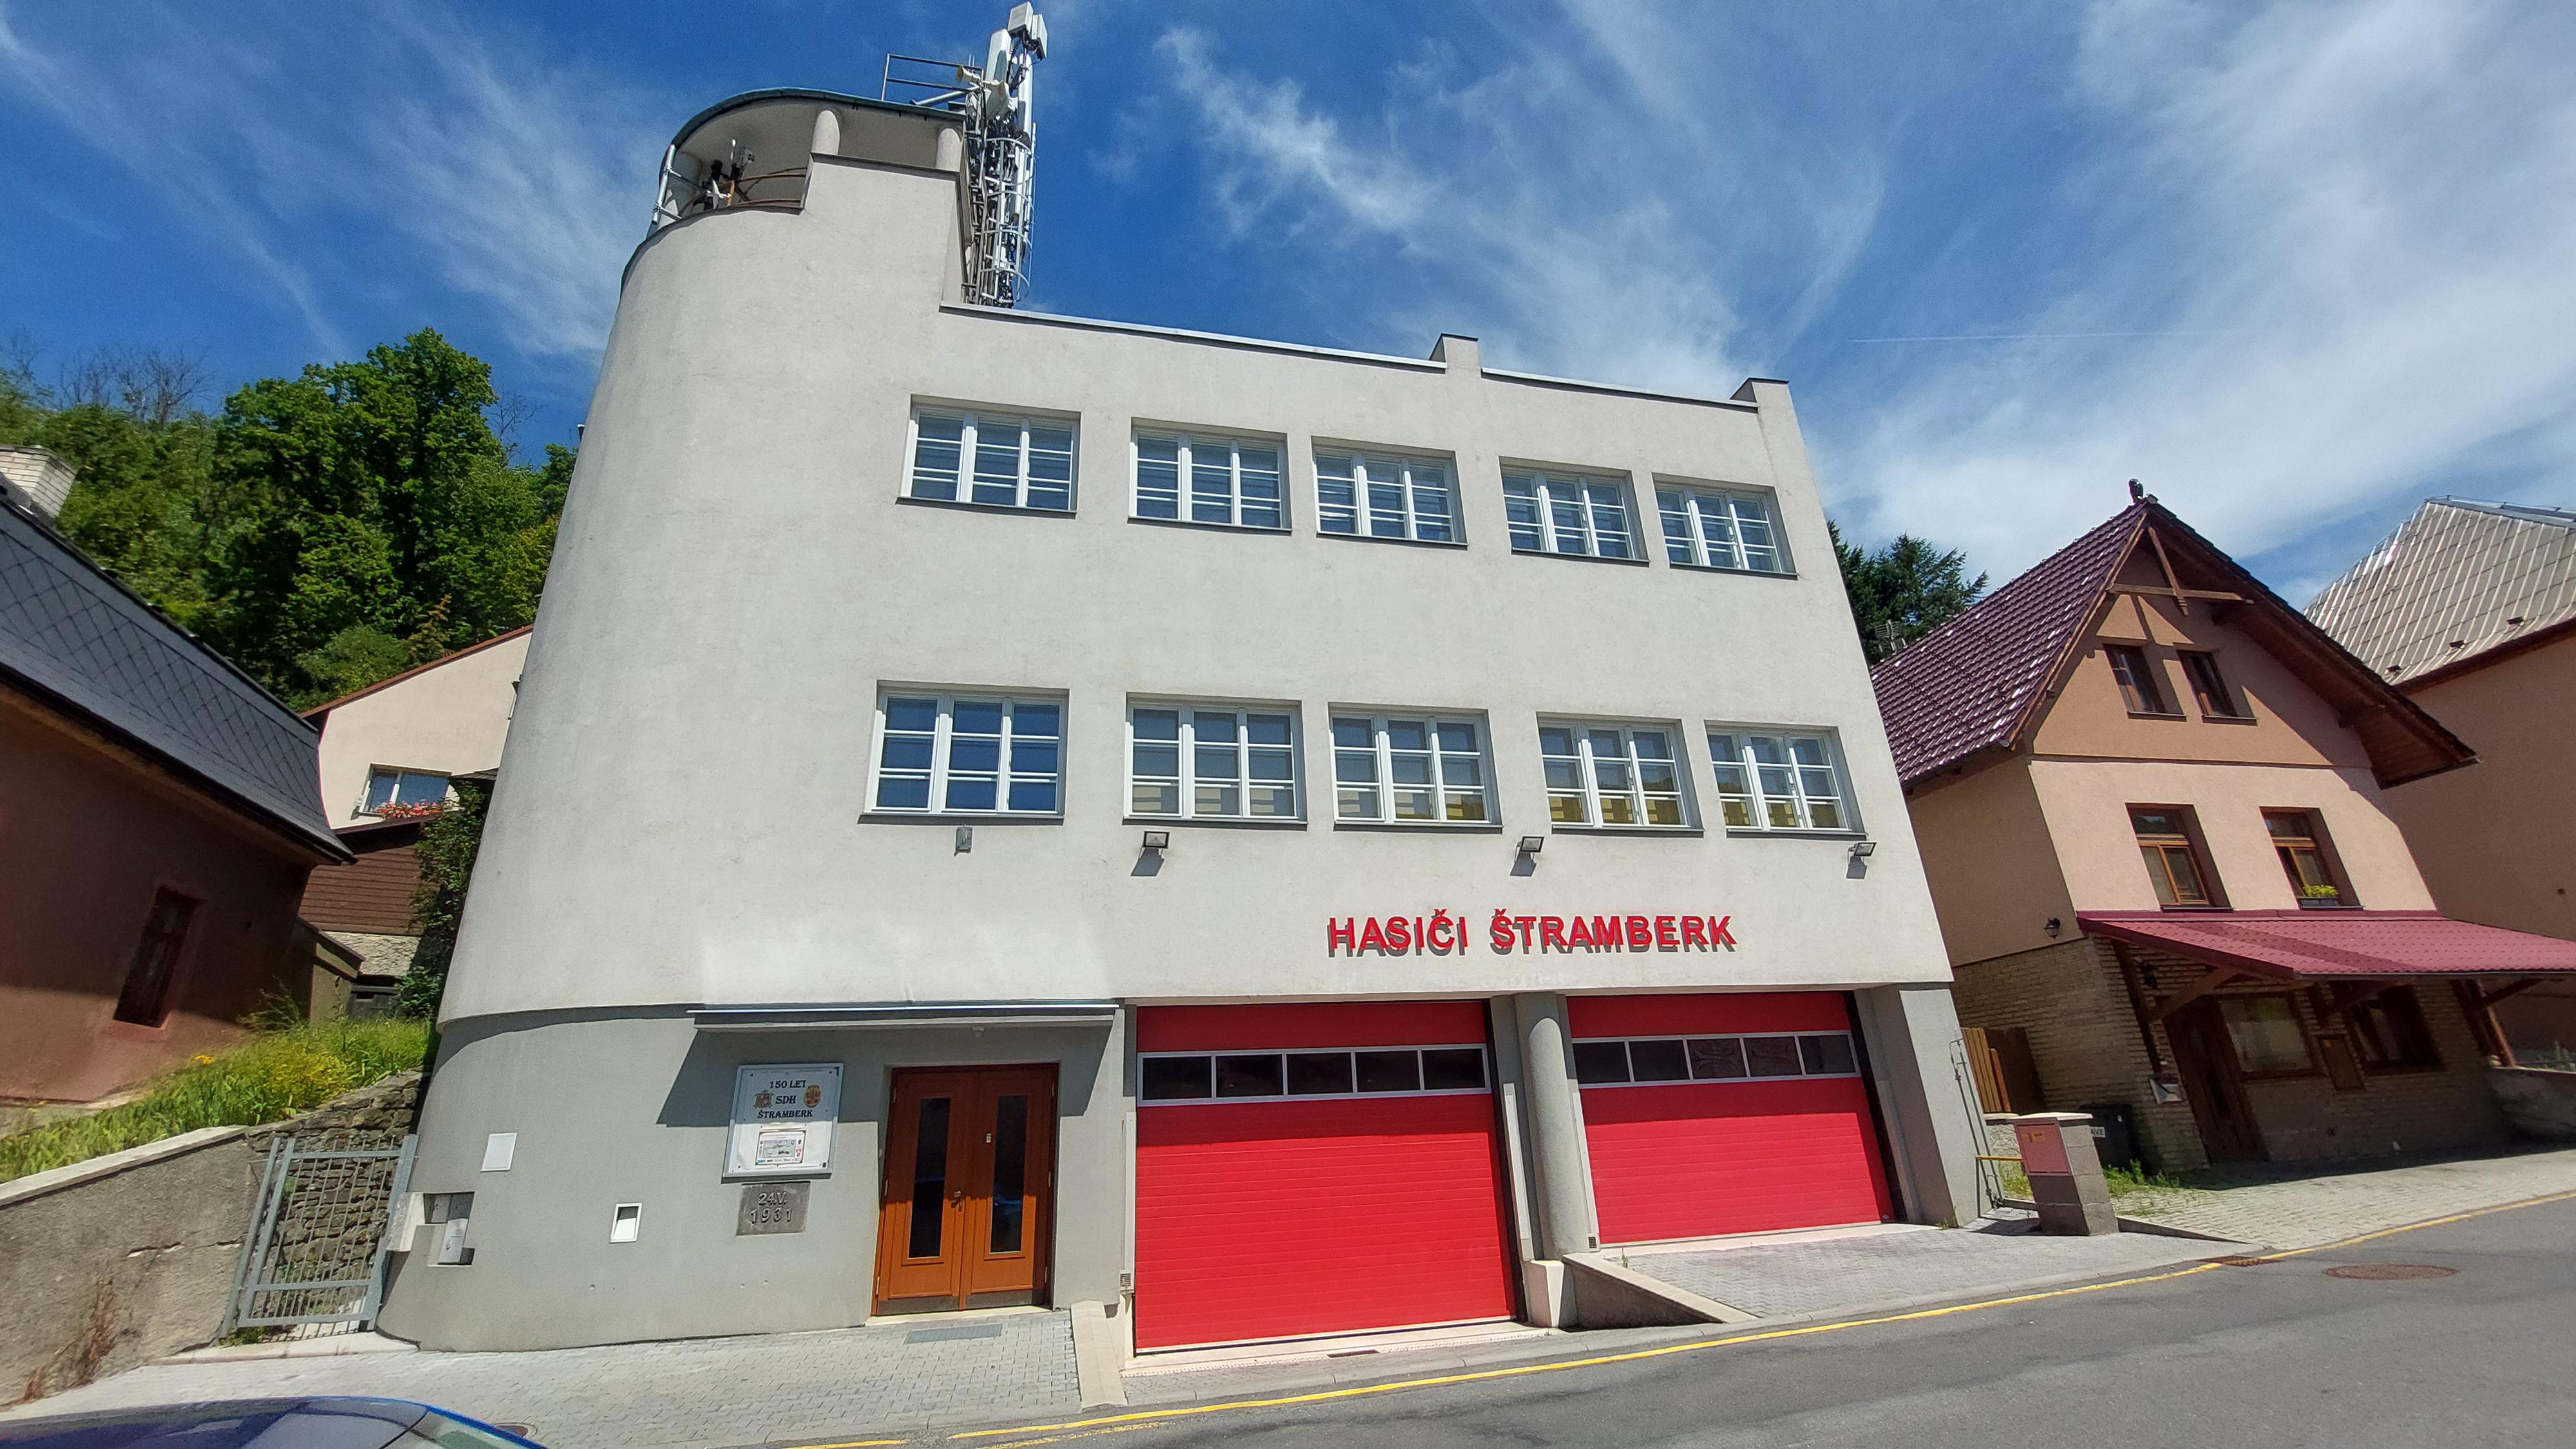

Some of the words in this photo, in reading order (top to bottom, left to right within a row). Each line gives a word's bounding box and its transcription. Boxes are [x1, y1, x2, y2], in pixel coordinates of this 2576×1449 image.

[1329, 908, 1468, 951] HASIČI
[1491, 908, 1737, 949] ŠTRAMBERK
[770, 1080, 788, 1089] 150
[789, 1079, 807, 1088] LET
[775, 1095, 797, 1104] SDH
[757, 1109, 813, 1119] ŠTRAMBERK
[750, 1208, 793, 1224] 1931
